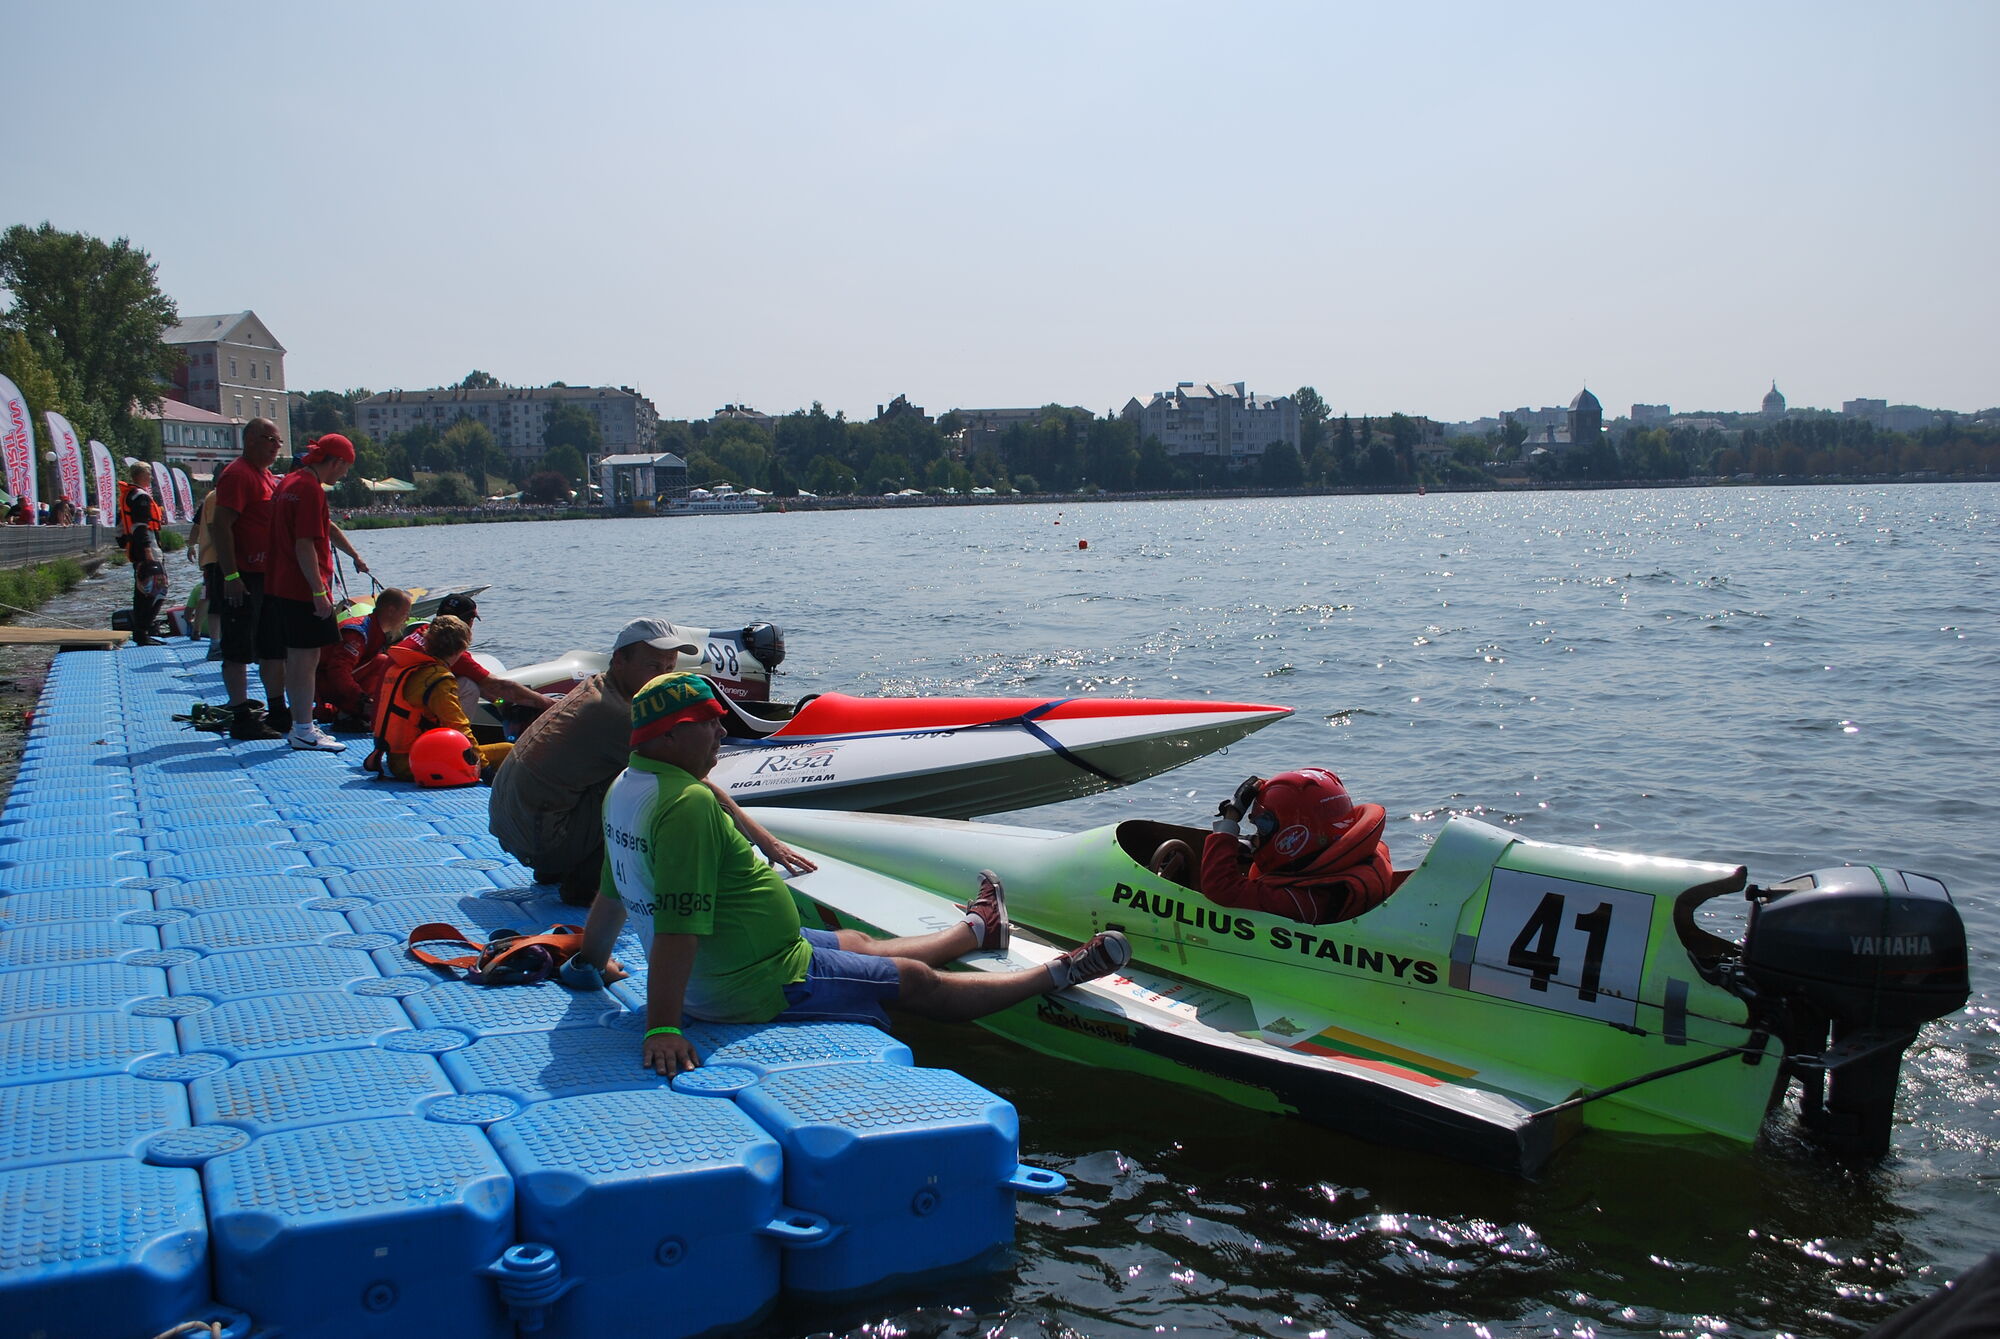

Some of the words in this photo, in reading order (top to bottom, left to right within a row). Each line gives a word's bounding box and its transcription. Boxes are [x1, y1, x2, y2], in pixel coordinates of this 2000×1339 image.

[707, 642, 739, 677] 98
[730, 780, 761, 789] RIGA
[801, 773, 835, 783] TEAM
[1112, 882, 1256, 941] PAULIUS
[1270, 926, 1439, 985] STAINYS
[1507, 891, 1614, 1003] 41
[1850, 935, 1932, 955] YAMAHA
